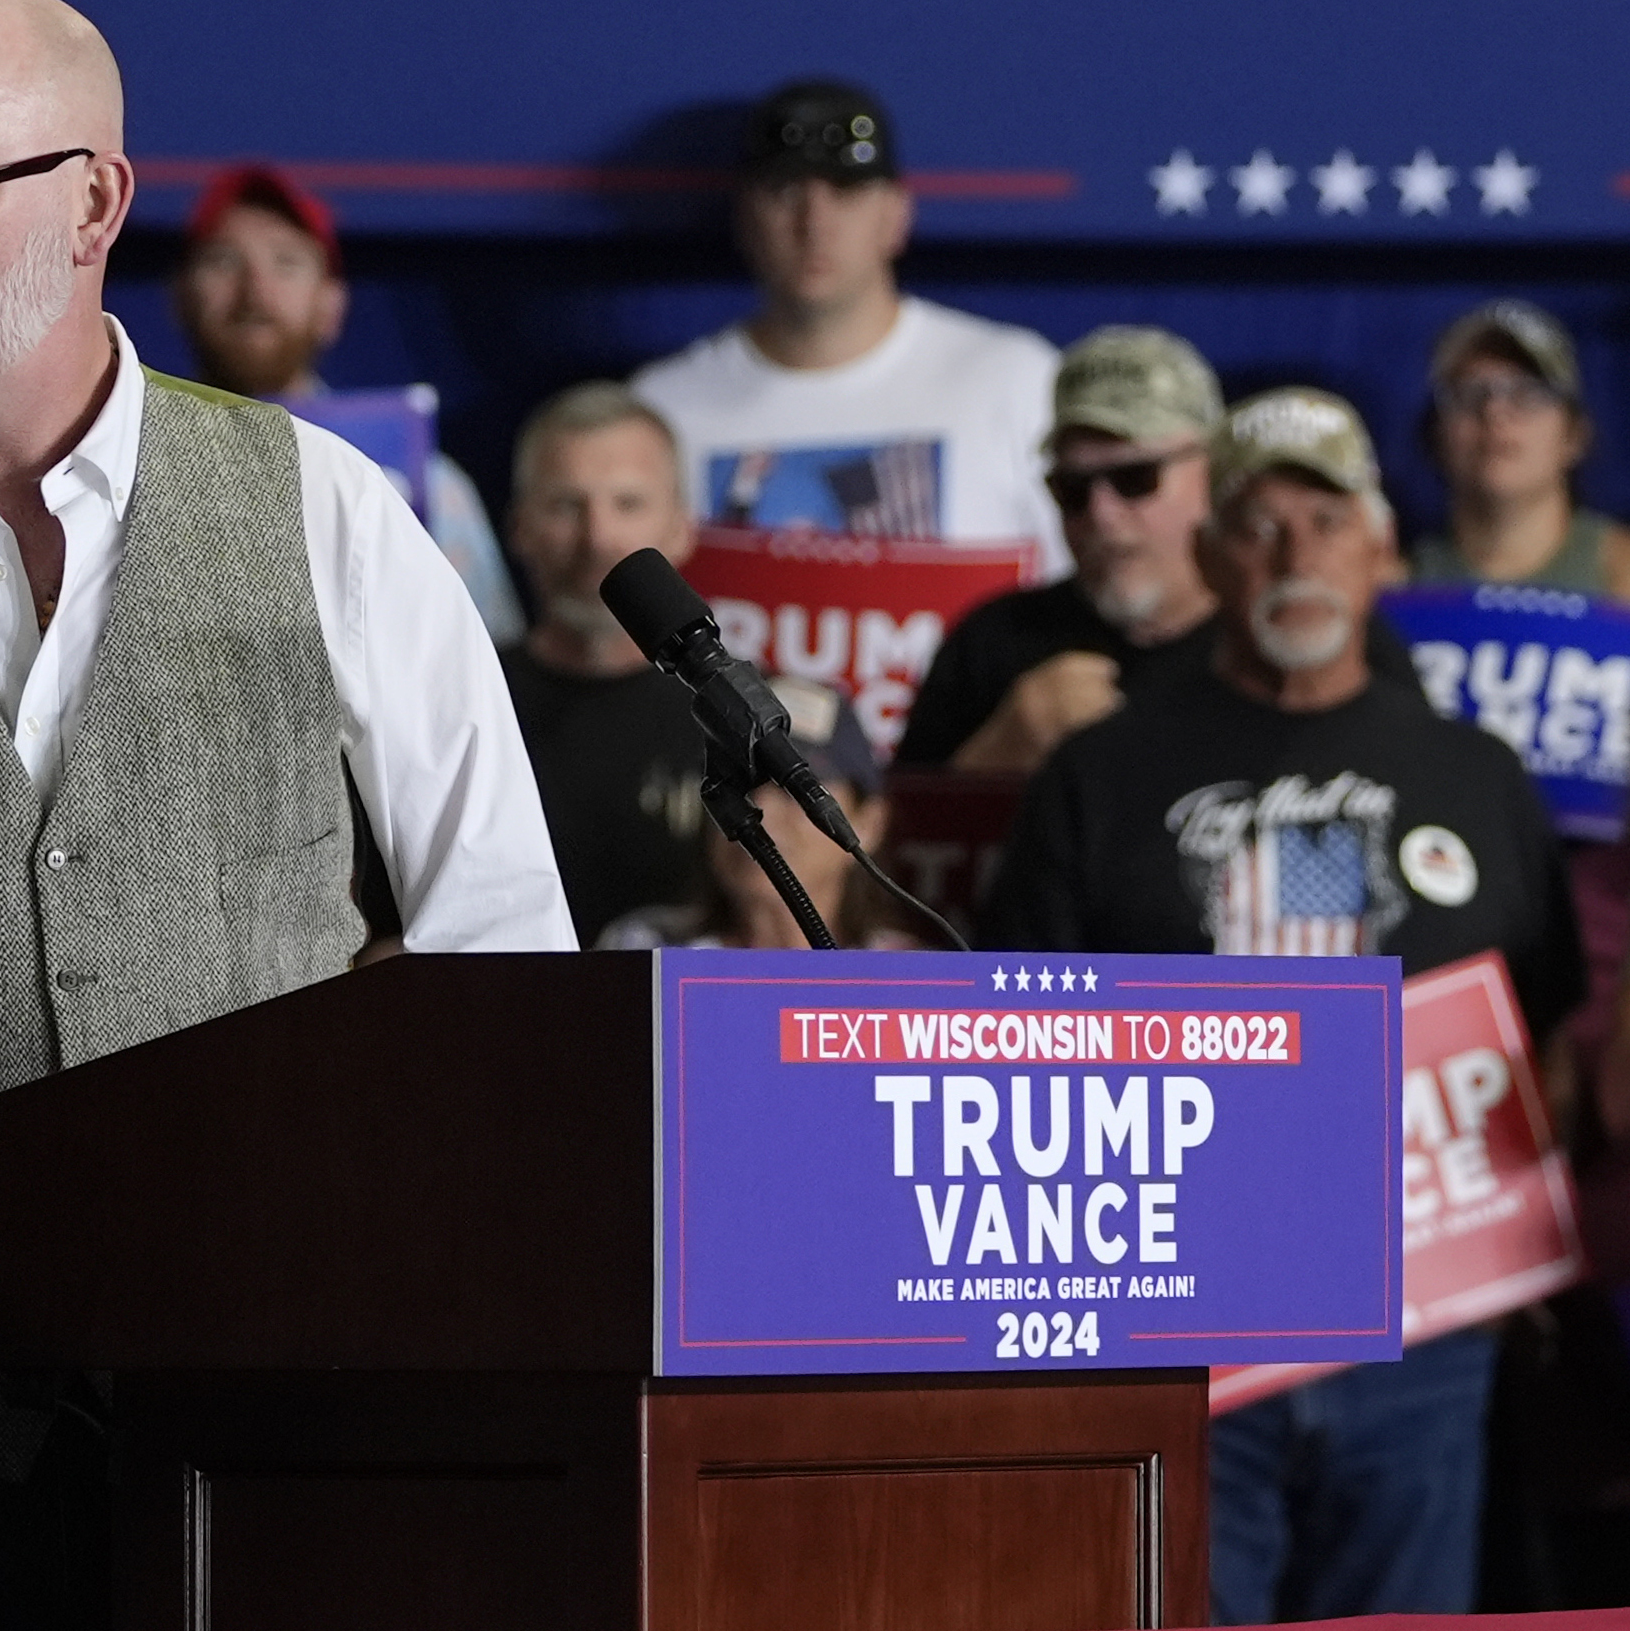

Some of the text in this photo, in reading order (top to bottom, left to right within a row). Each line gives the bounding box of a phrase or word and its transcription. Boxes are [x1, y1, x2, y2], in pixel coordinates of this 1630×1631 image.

[793, 1012, 1289, 1062] TEXT WISCONSIN TO 88022
[874, 1074, 1216, 1178] TRUMP
[913, 1181, 1178, 1266] VANCE
[897, 1274, 1195, 1302] MAKE AMERICA GREAT AGAIN!
[996, 1311, 1101, 1359] 2024
